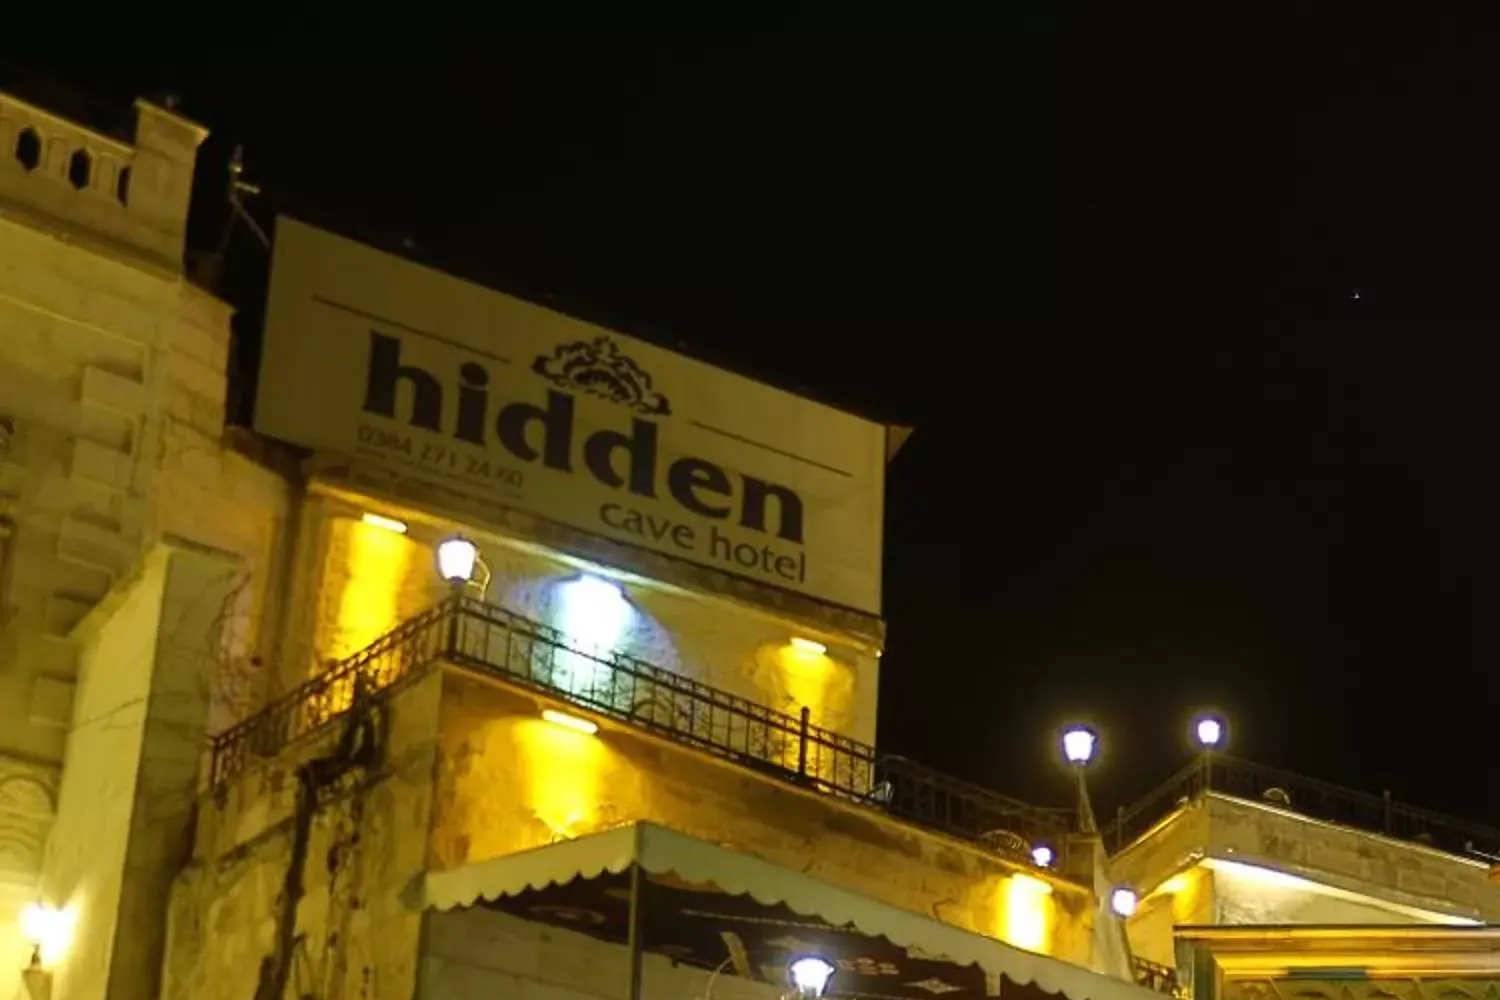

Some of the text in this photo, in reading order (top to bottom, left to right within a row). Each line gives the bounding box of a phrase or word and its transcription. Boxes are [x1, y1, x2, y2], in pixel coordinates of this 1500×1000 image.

[363, 329, 804, 544] hidden
[600, 503, 806, 584] cave hotel
